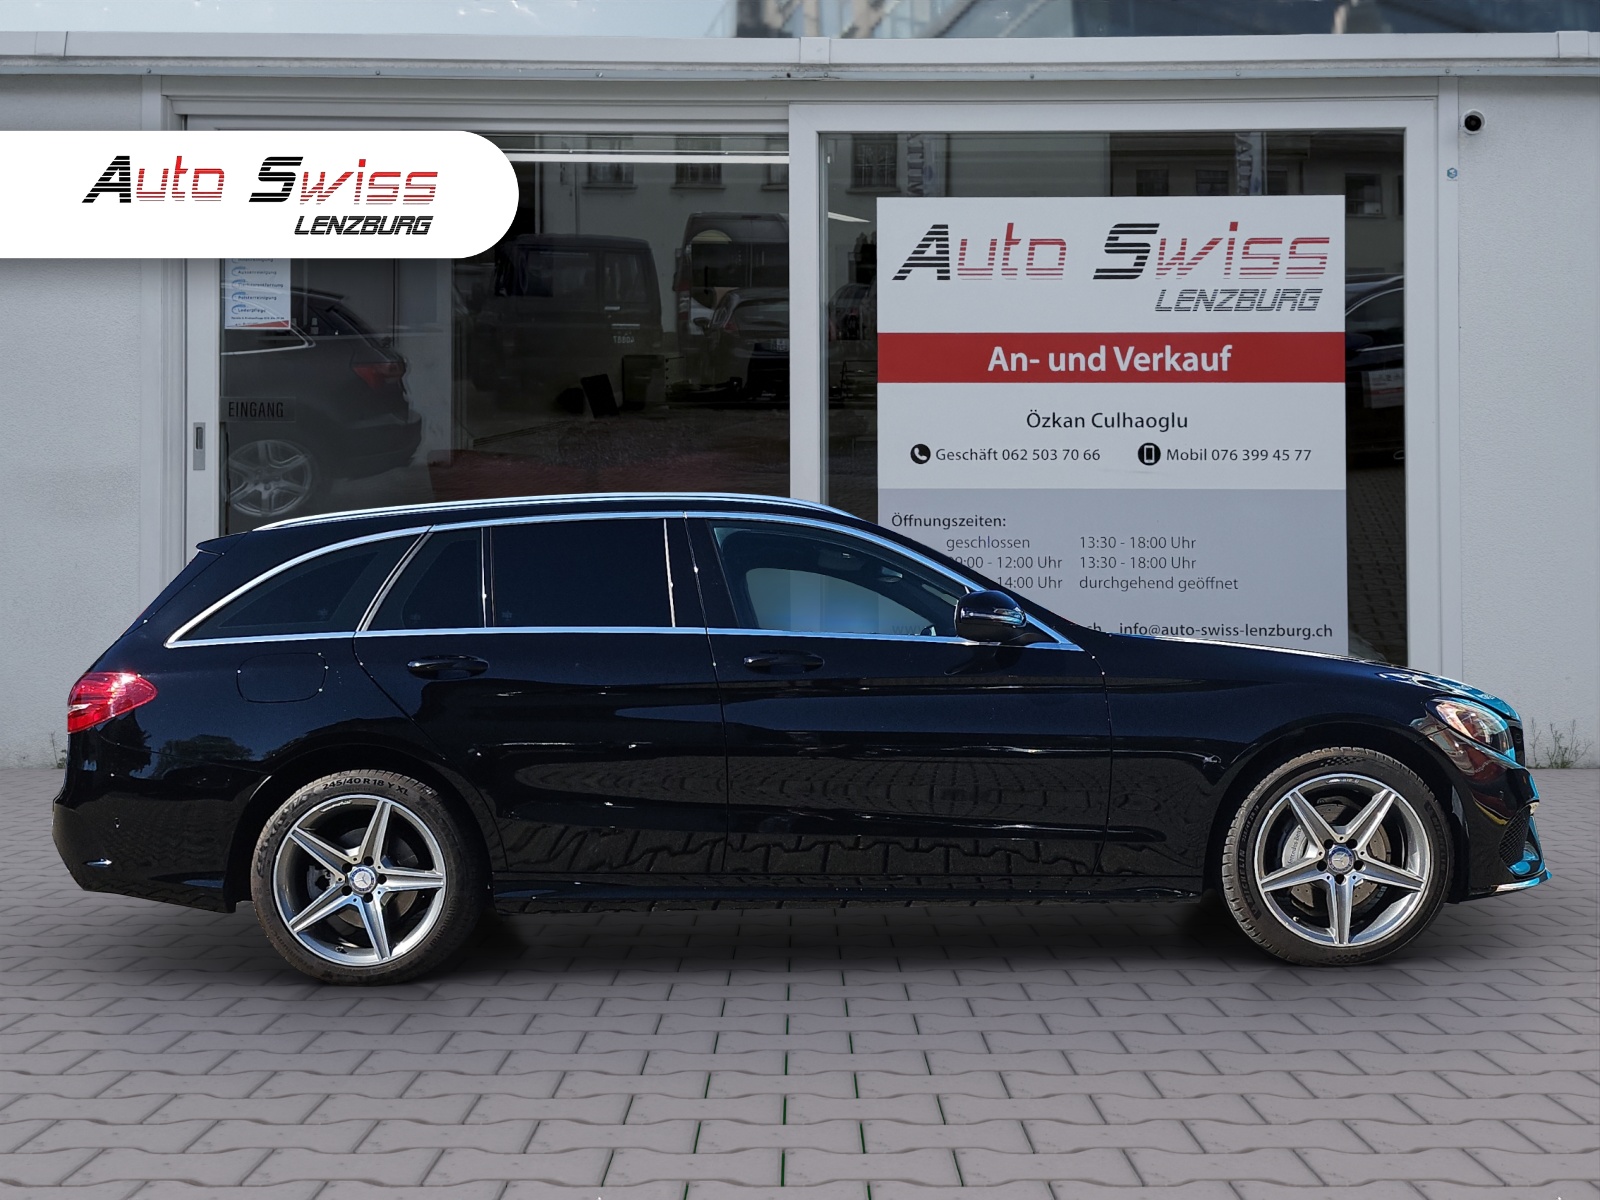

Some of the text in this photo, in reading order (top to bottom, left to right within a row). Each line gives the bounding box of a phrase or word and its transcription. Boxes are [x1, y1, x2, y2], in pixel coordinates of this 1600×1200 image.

[892, 222, 1330, 280] Auto Swiss
[1155, 288, 1323, 312] LENZBURG
[987, 345, 1233, 372] An- und Verkauf
[228, 401, 284, 418] EINGANG
[1026, 409, 1189, 432] Özkan Culhaoglu
[935, 448, 1101, 462] Geschäft 062 503 70 66
[1166, 447, 1312, 461] Mobil 076 399 45 77
[891, 512, 1007, 530] Öffnungszeiten:
[946, 535, 1030, 551] geschlossen
[1080, 536, 1117, 549] 13:30
[1130, 536, 1167, 549] 18:00
[1171, 535, 1197, 549] Uhr
[997, 556, 1033, 569] 12:00
[1037, 556, 1063, 569] Uhr
[1080, 556, 1117, 569] 13:30
[1130, 556, 1167, 569] 18:00
[1171, 556, 1197, 569] Uhr
[1037, 576, 1063, 589] Uhr
[1079, 575, 1174, 592] durchgehend
[1178, 576, 1239, 592] geöffnet
[1119, 621, 1333, 640] info@auto-swiss-lenzburg.ch
[322, 777, 361, 791] 245/40
[372, 779, 385, 787] 18
[387, 781, 395, 789] Y
[396, 785, 409, 797] XL
[1237, 847, 1255, 904] MICHELIN
